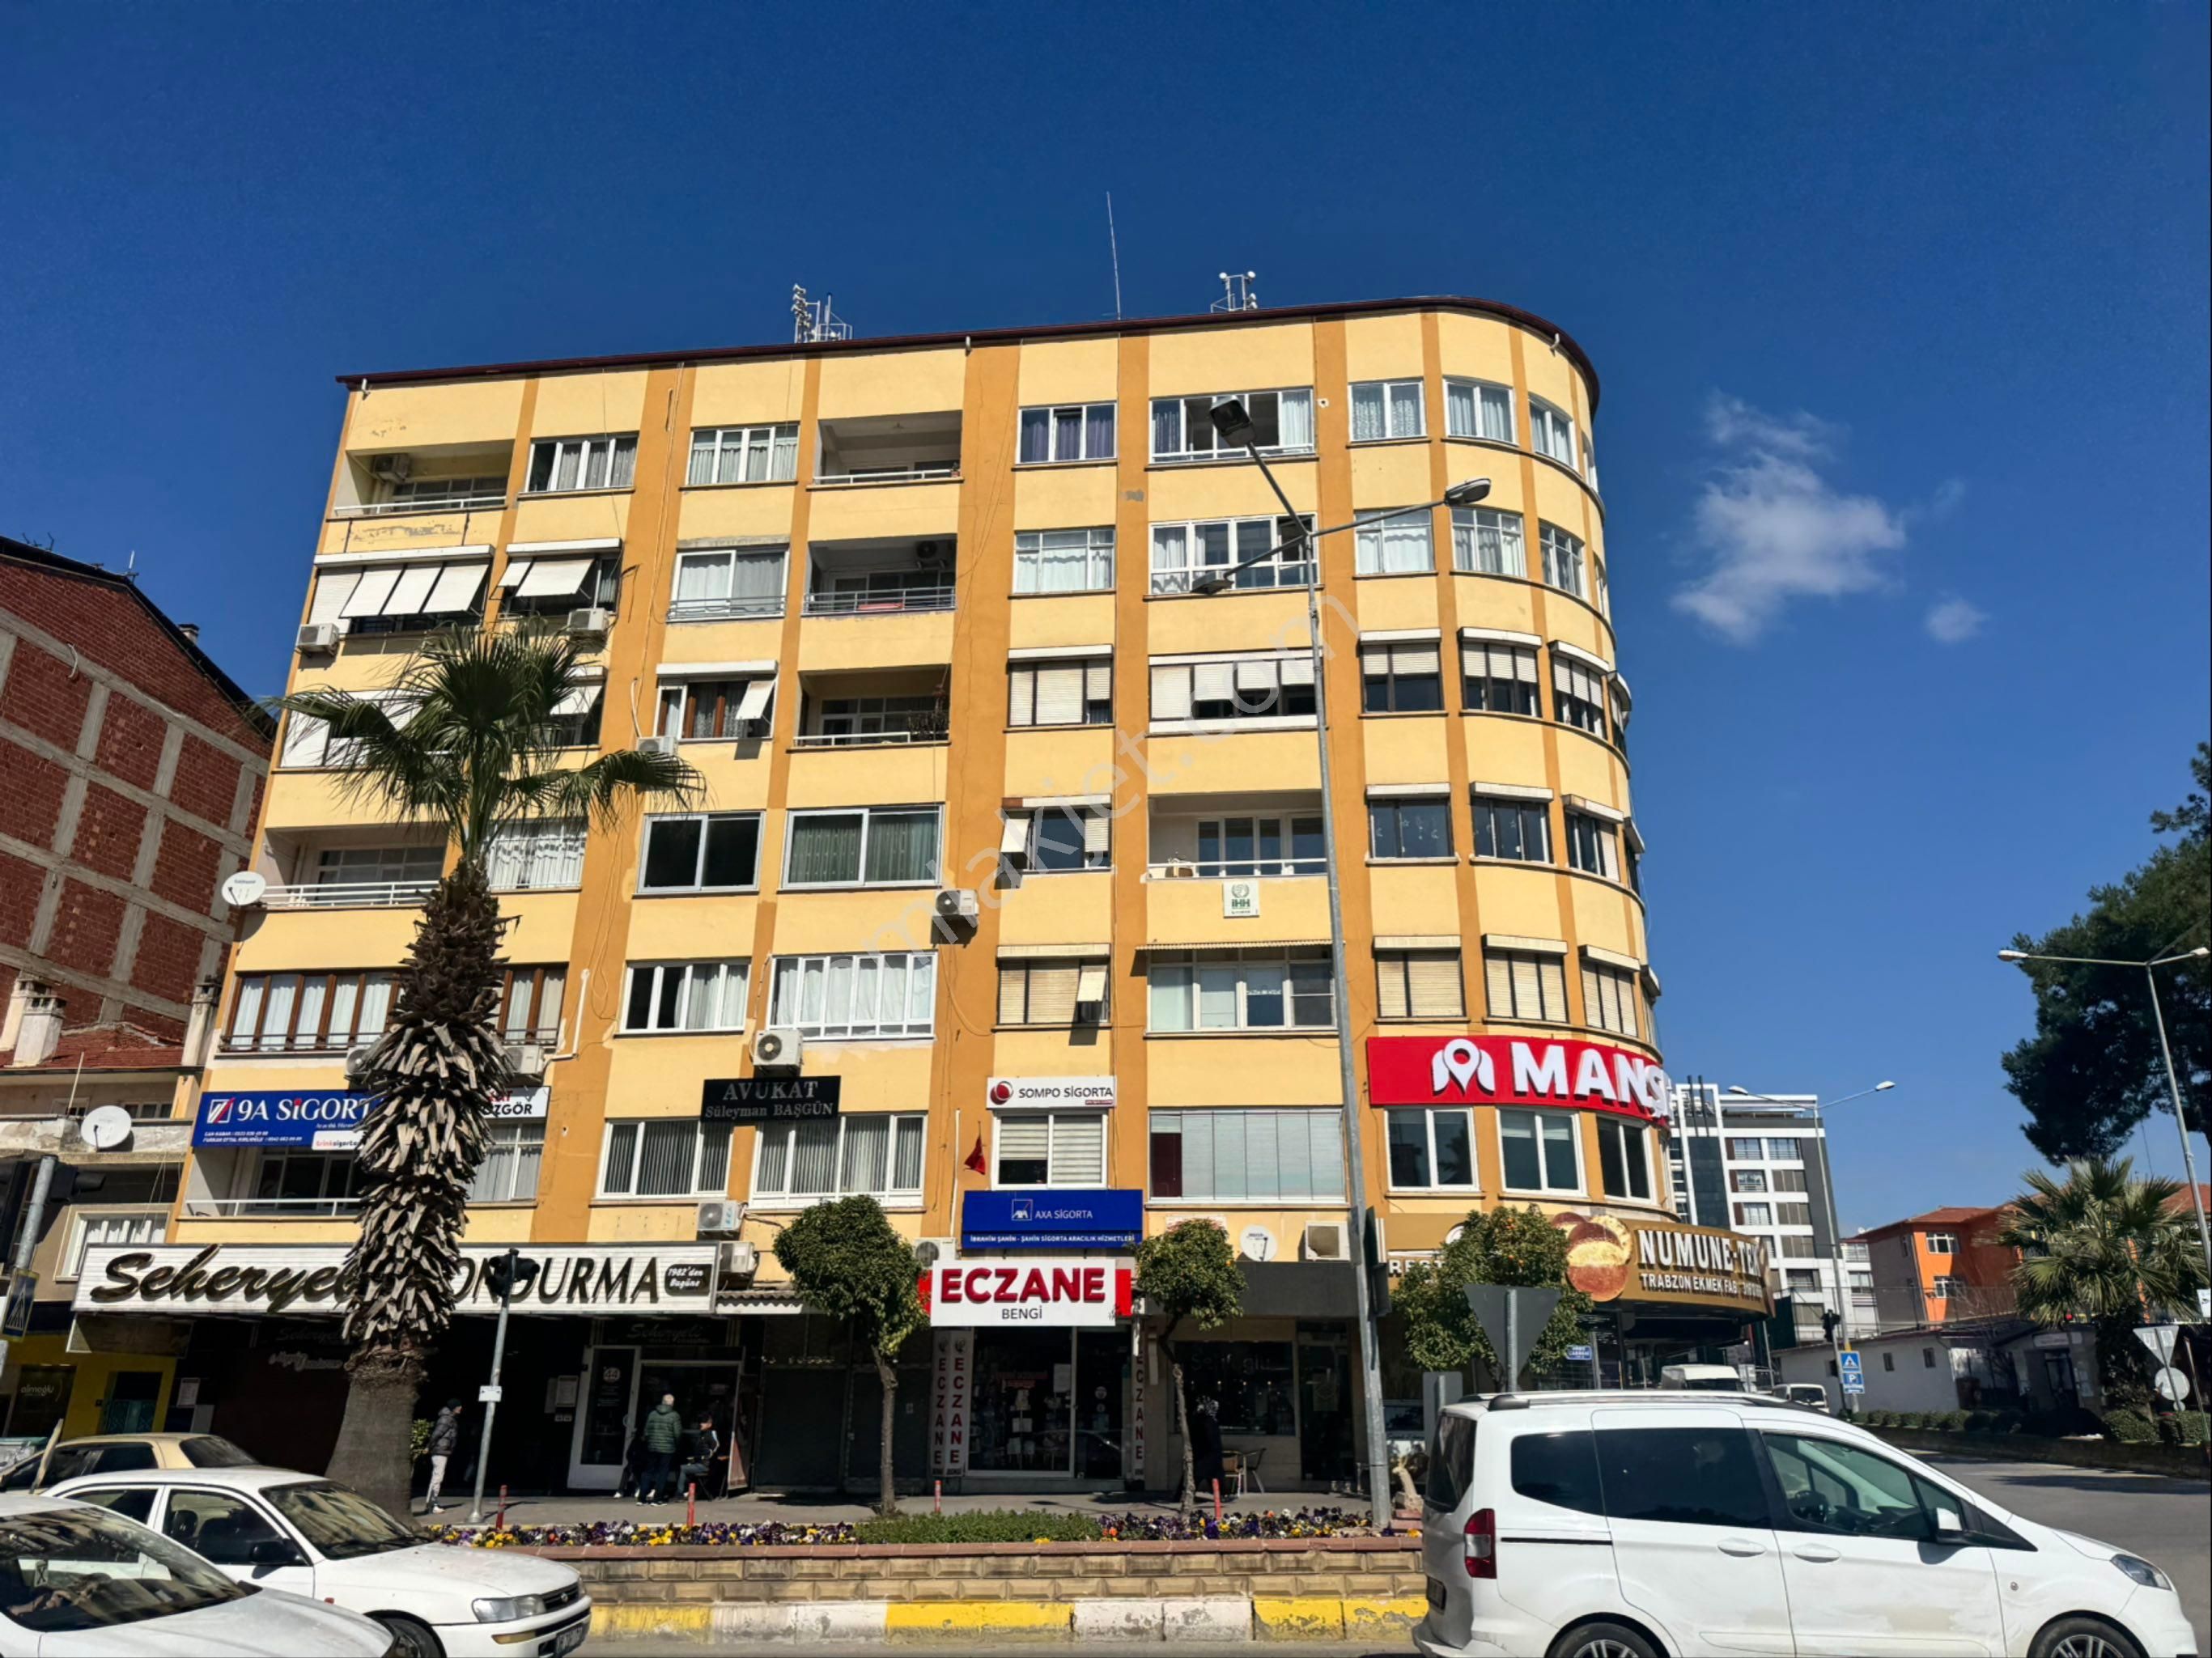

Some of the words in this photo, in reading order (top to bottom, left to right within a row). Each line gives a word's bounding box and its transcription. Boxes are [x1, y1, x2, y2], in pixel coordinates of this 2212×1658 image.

[722, 1081, 818, 1100] AVUKAT
[1018, 1088, 1060, 1098] SOMPO
[1064, 1085, 1113, 1097] SİGORTA
[237, 1100, 269, 1121] 9A
[705, 1105, 767, 1120] Süleyman
[773, 1101, 834, 1118] BAŞGÜN
[1035, 1211, 1052, 1219] AXA
[1054, 1208, 1093, 1219] SİGORTA
[940, 1267, 1106, 1304] ECZANE
[1641, 1273, 1692, 1289] TRABZON
[1693, 1276, 1724, 1292] EKMEK
[1001, 1305, 1042, 1320] BENGİ
[950, 1357, 964, 1464] ECZANE
